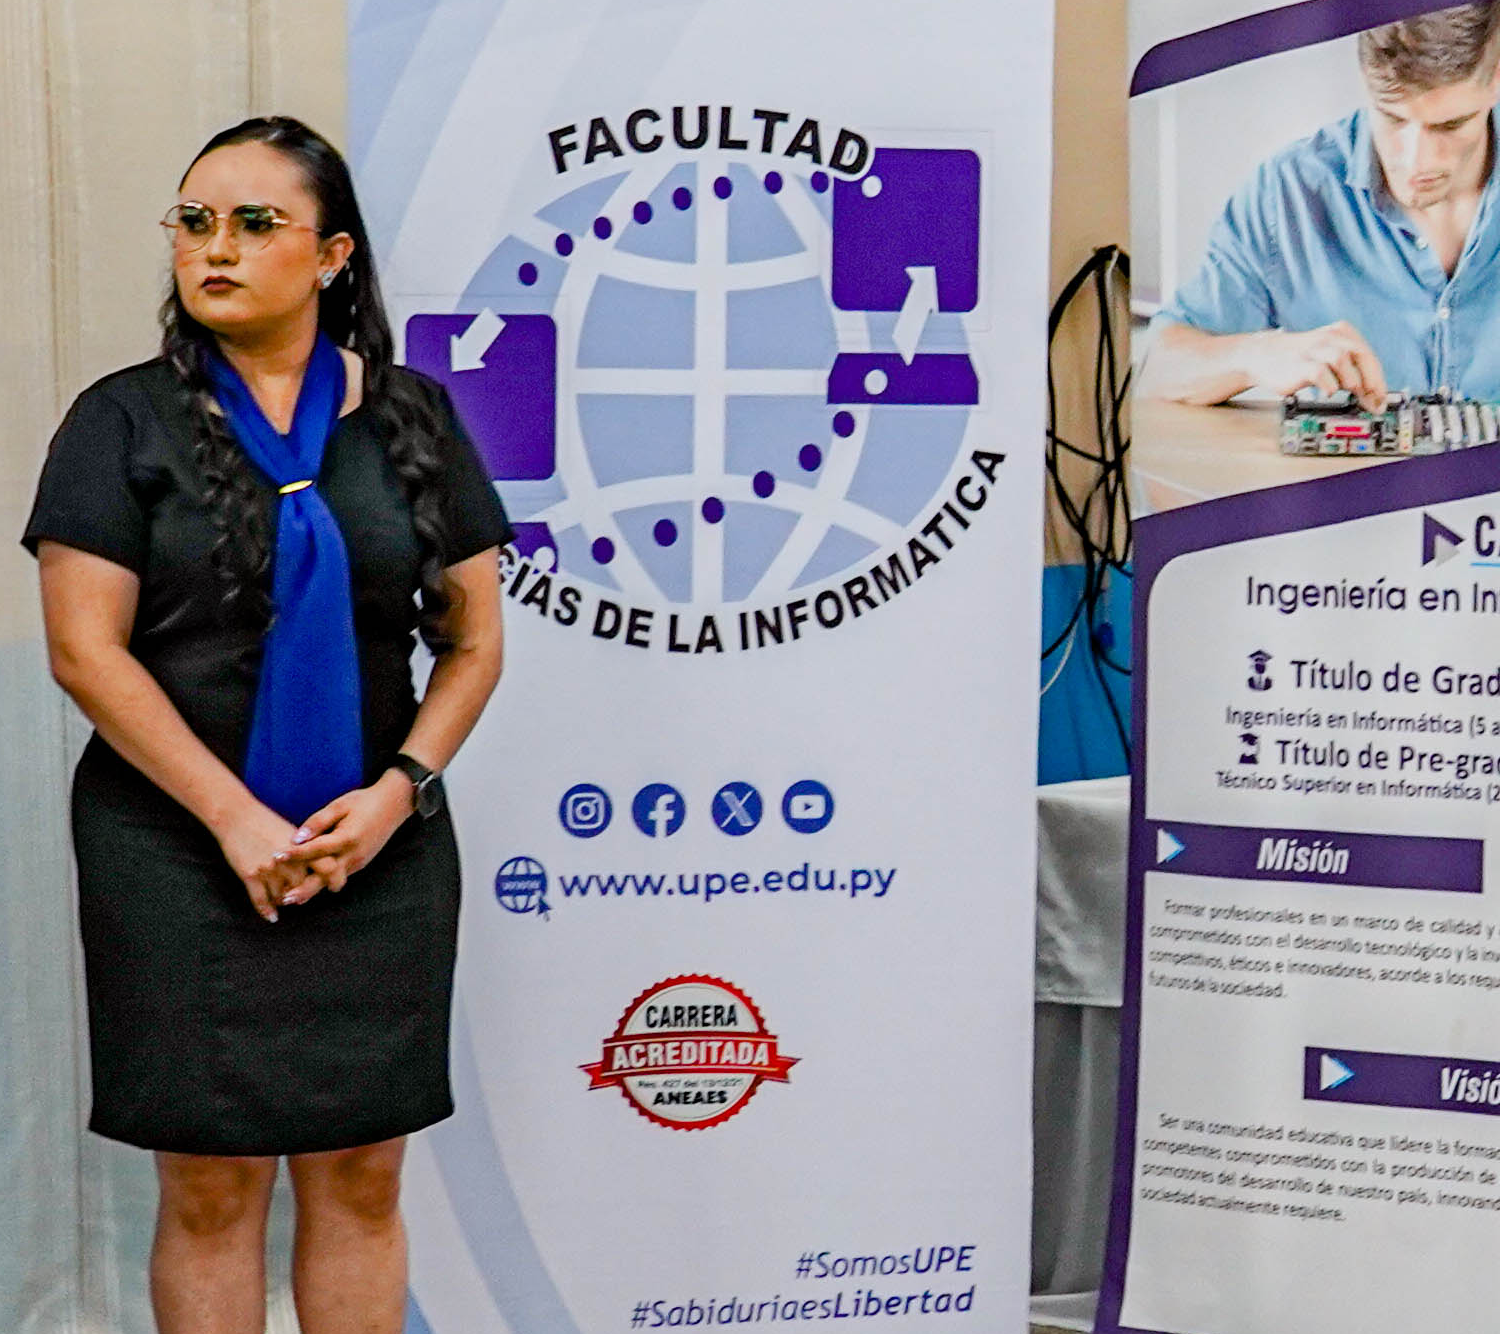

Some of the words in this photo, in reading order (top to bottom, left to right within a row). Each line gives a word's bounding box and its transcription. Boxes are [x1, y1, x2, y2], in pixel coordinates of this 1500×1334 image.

[547, 105, 870, 176] FACULTAD
[592, 600, 651, 649] DE
[668, 614, 723, 655] LA
[739, 447, 1007, 652] INFORMATICA
[1247, 576, 1406, 614] Ingeniería
[1419, 588, 1459, 611] en
[1289, 658, 1371, 691] Título
[1383, 662, 1420, 693] de
[1226, 706, 1321, 729] Ingeniería
[1326, 714, 1347, 728] en
[1352, 710, 1463, 734] Informática
[1469, 714, 1485, 737] (5
[1275, 738, 1349, 767] Título
[1358, 742, 1388, 770] de
[1215, 770, 1276, 790] Técnico
[1282, 773, 1351, 795] Superior
[1355, 781, 1376, 795] en
[1381, 778, 1481, 800] Informática
[1486, 783, 1500, 804] (2
[1256, 837, 1349, 874] Misión
[559, 862, 896, 902] www.upe.edu.py
[645, 1003, 738, 1028] CARRERA
[612, 1041, 770, 1070] ACREDITADA
[653, 1090, 728, 1105] ANEAES
[795, 1245, 976, 1278] #SomosUPE
